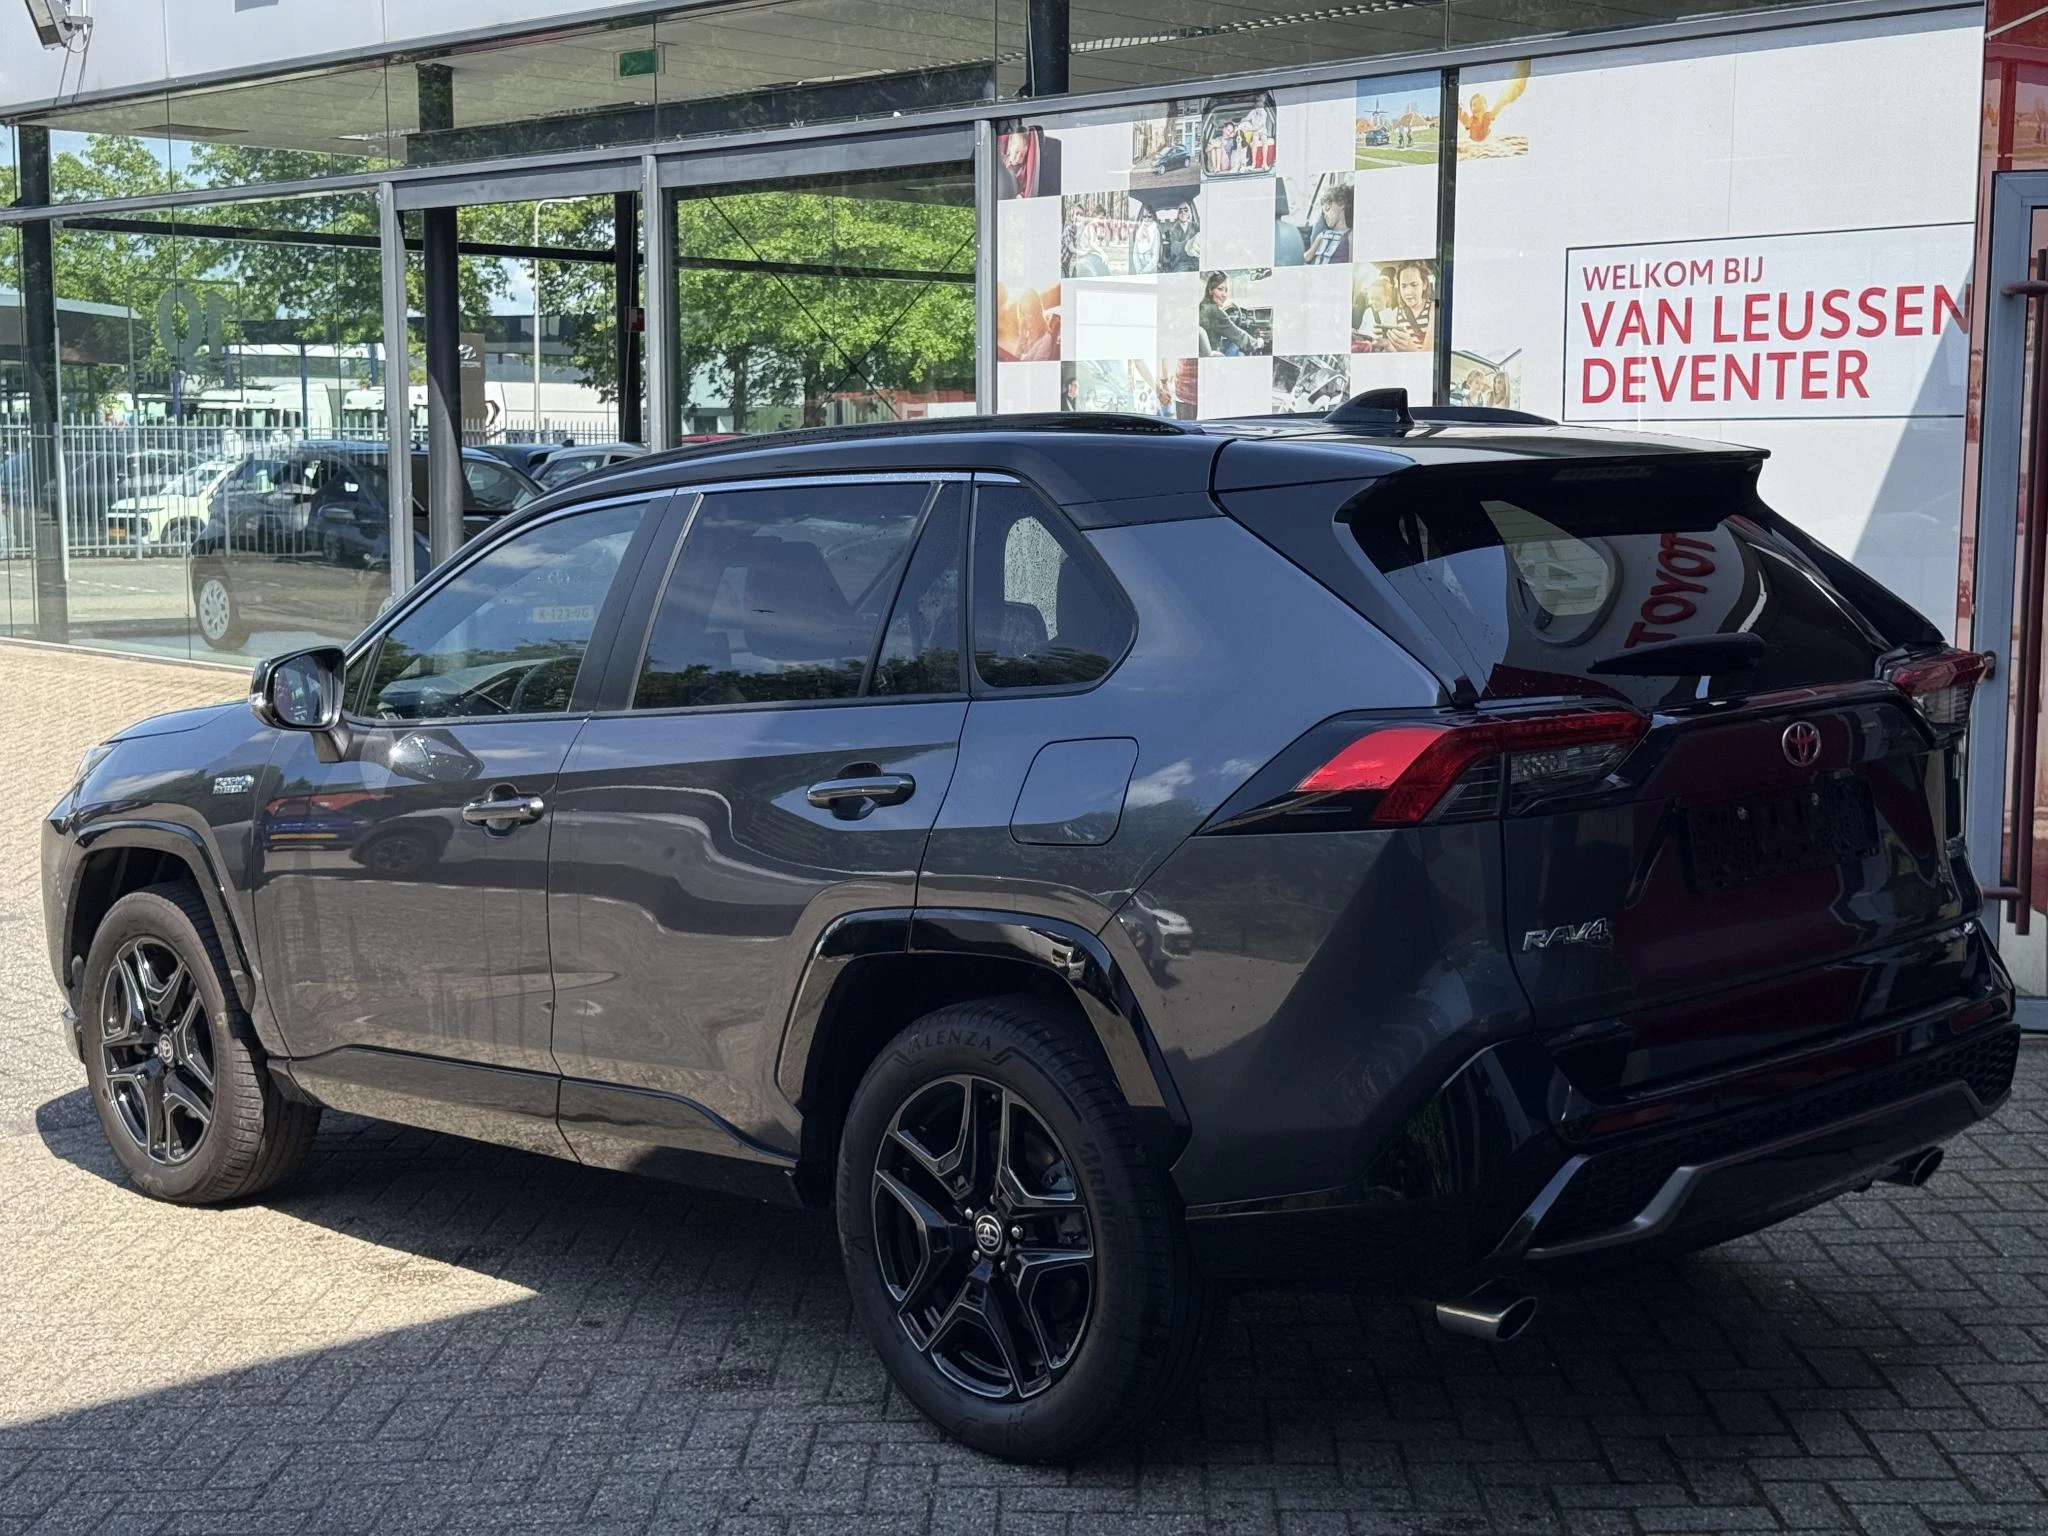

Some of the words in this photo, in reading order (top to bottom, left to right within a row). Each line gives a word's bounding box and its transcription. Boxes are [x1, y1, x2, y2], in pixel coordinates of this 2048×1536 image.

[1582, 259, 1713, 291] WELKOM
[1723, 256, 1764, 285] BIJ
[1581, 297, 1692, 347] VAN
[1713, 283, 1971, 344] LEUSSEN
[1582, 349, 1870, 404] DEVENTER
[1521, 916, 1610, 952] RAV4
